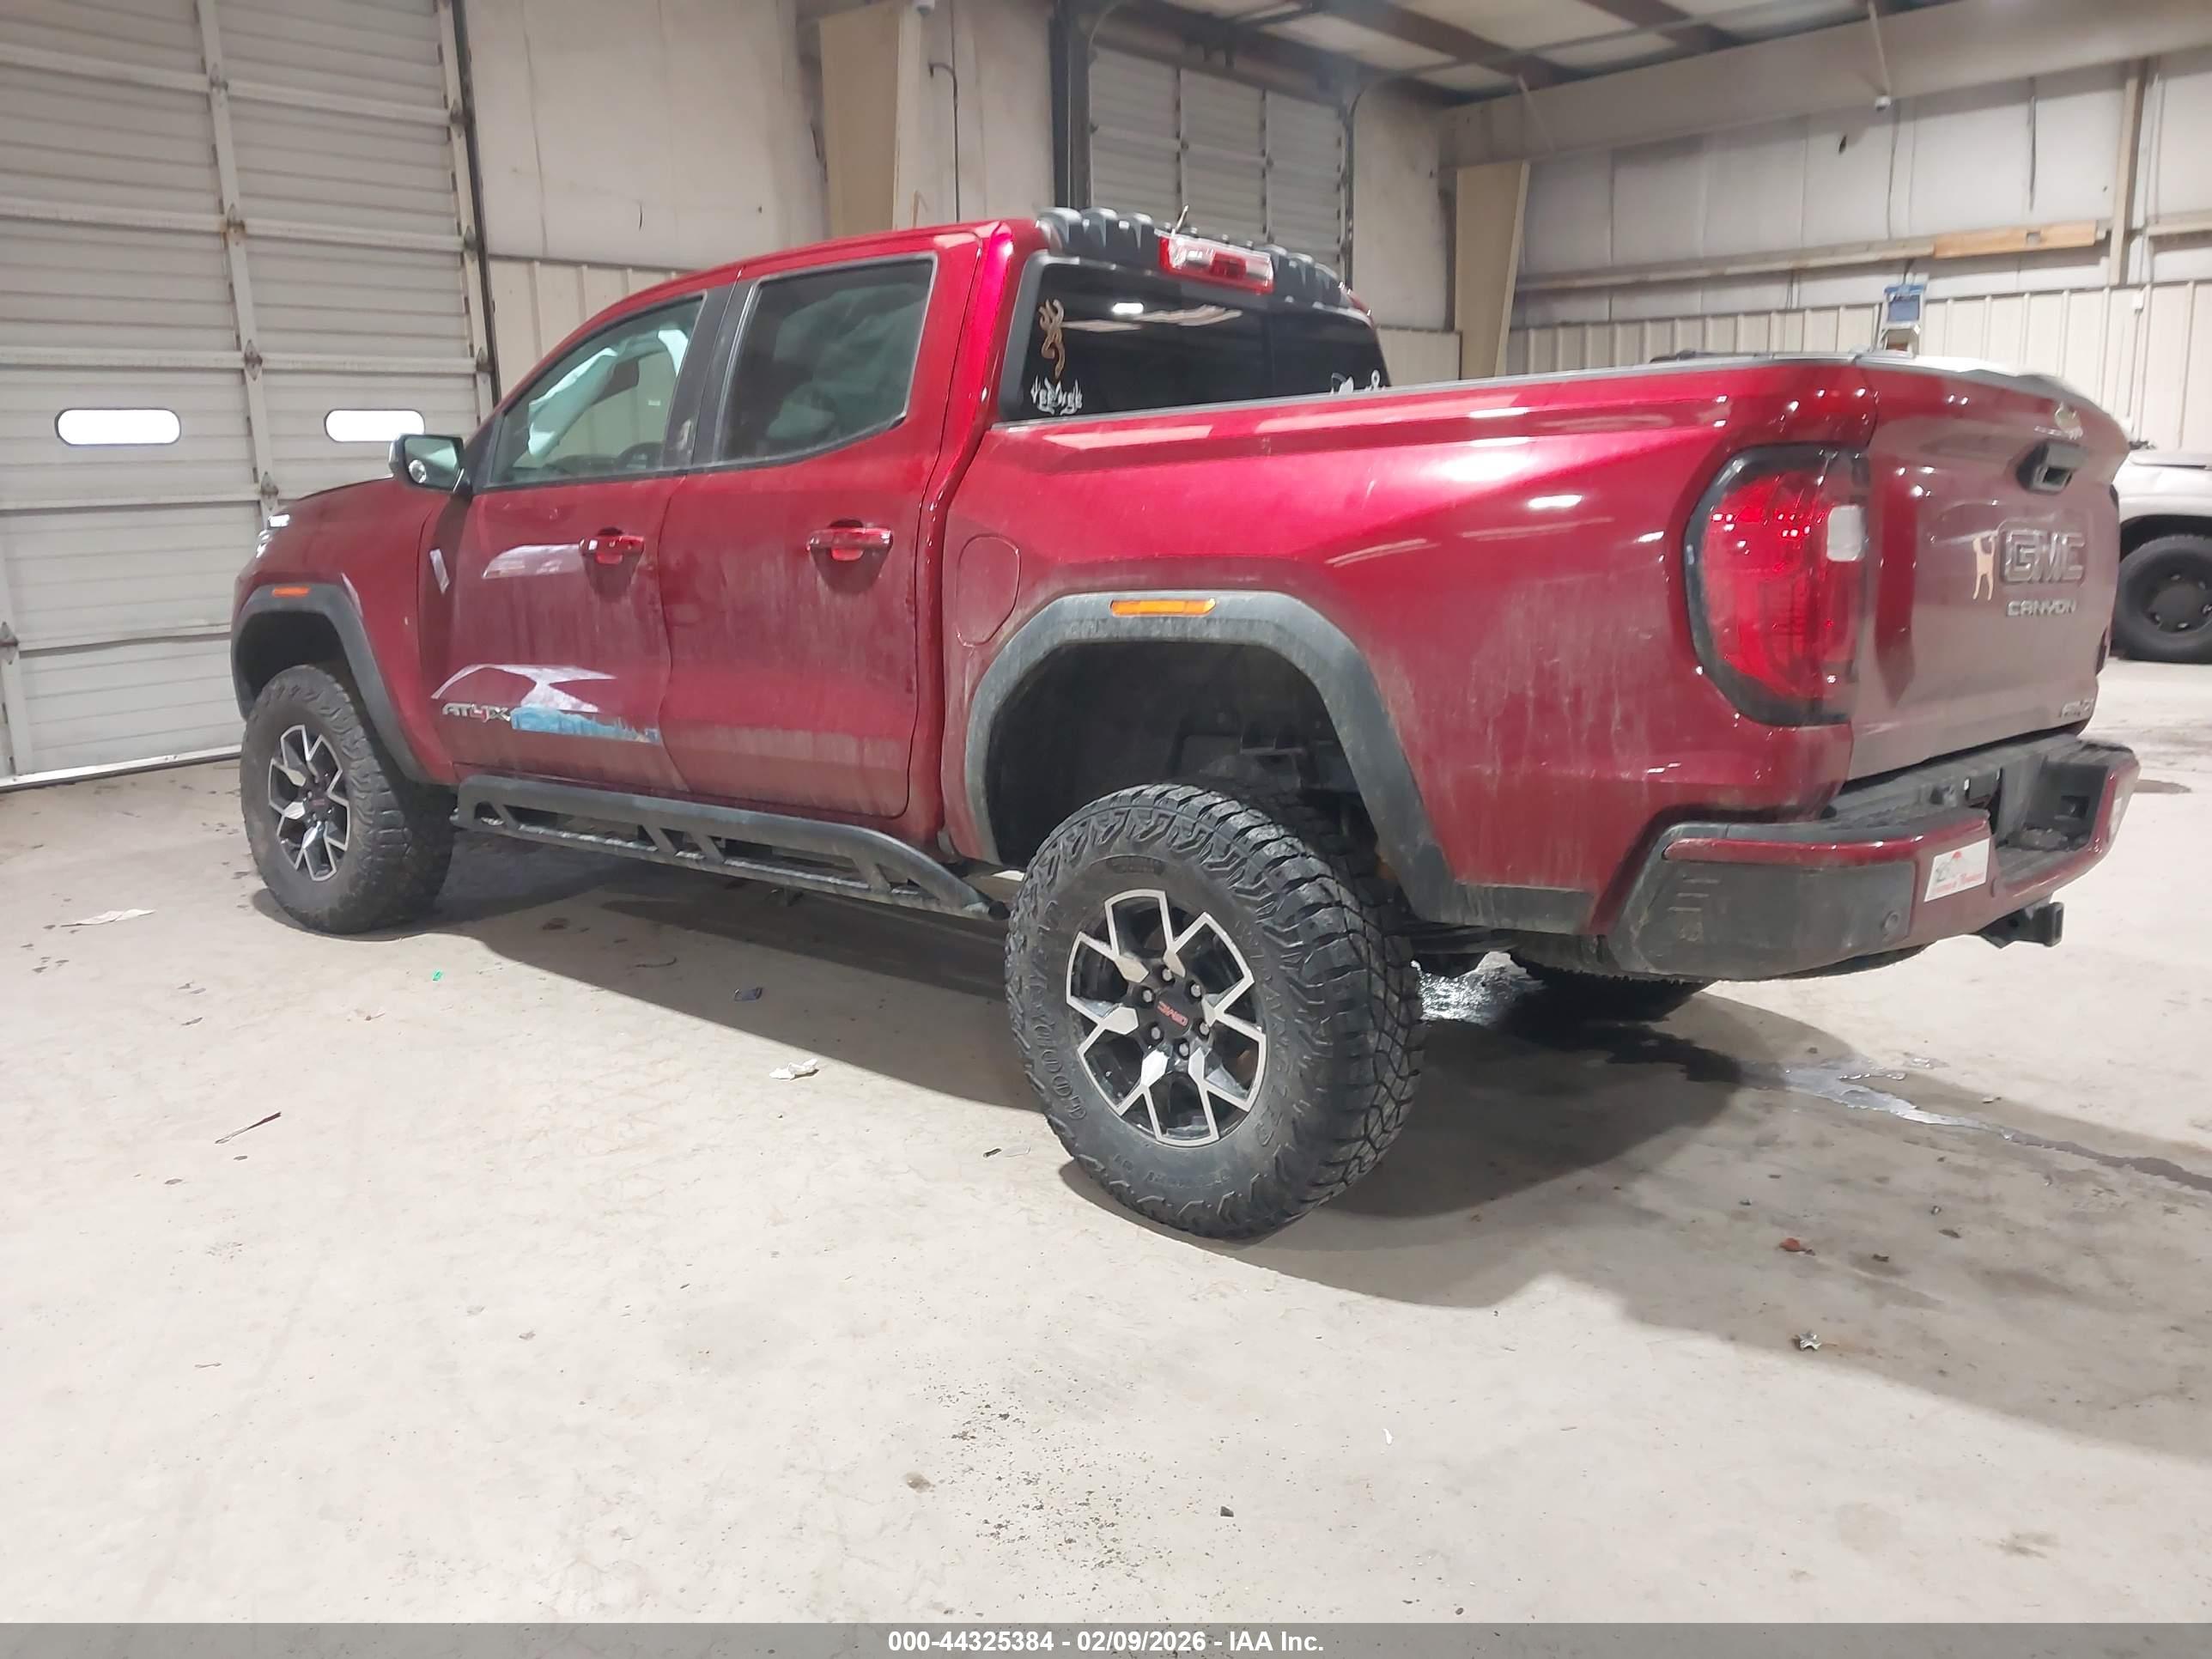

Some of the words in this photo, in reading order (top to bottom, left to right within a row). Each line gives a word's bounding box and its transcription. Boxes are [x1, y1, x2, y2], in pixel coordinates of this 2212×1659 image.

[2003, 528, 2086, 583] GMC
[2006, 599, 2077, 617] CANYON
[441, 702, 512, 723] AT4X
